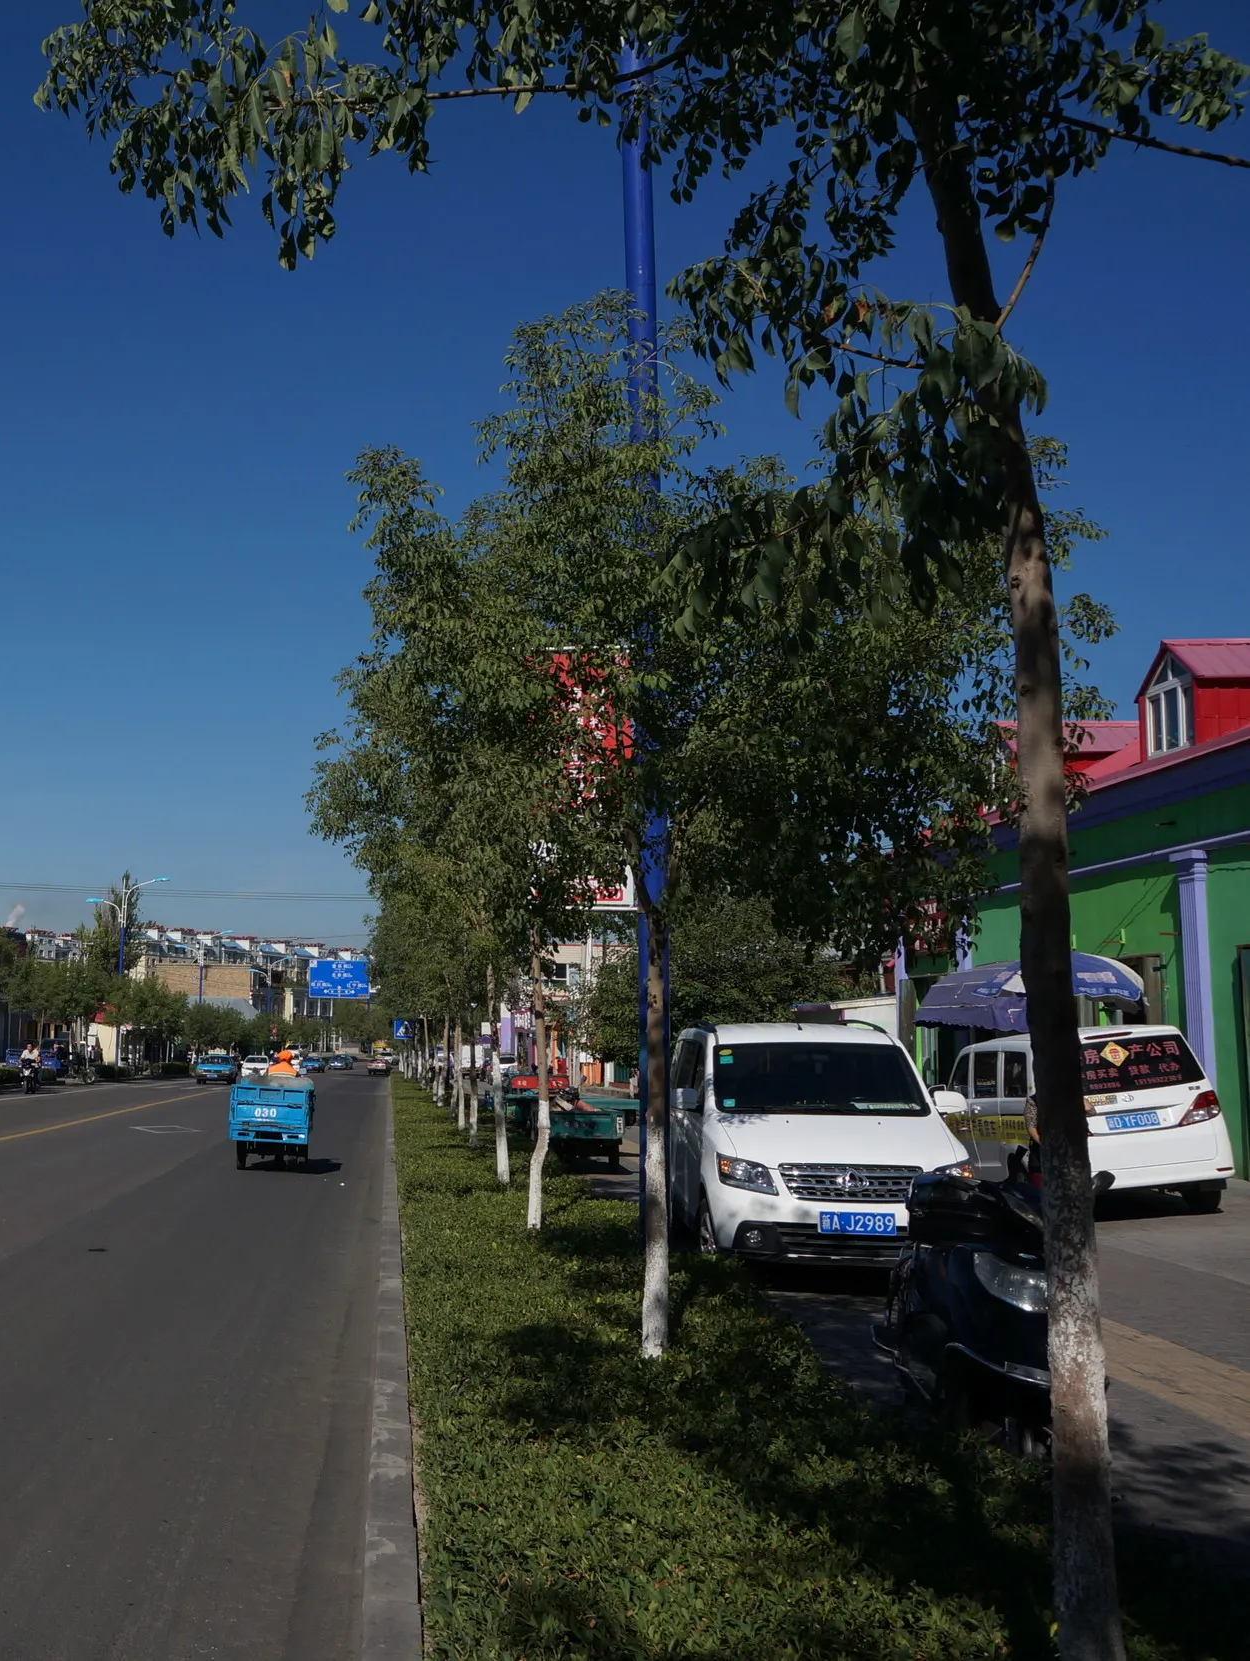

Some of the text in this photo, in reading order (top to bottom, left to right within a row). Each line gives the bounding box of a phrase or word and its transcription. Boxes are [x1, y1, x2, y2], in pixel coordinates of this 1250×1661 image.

[1084, 1041, 1181, 1065] 房产公司
[254, 1108, 277, 1118] 030
